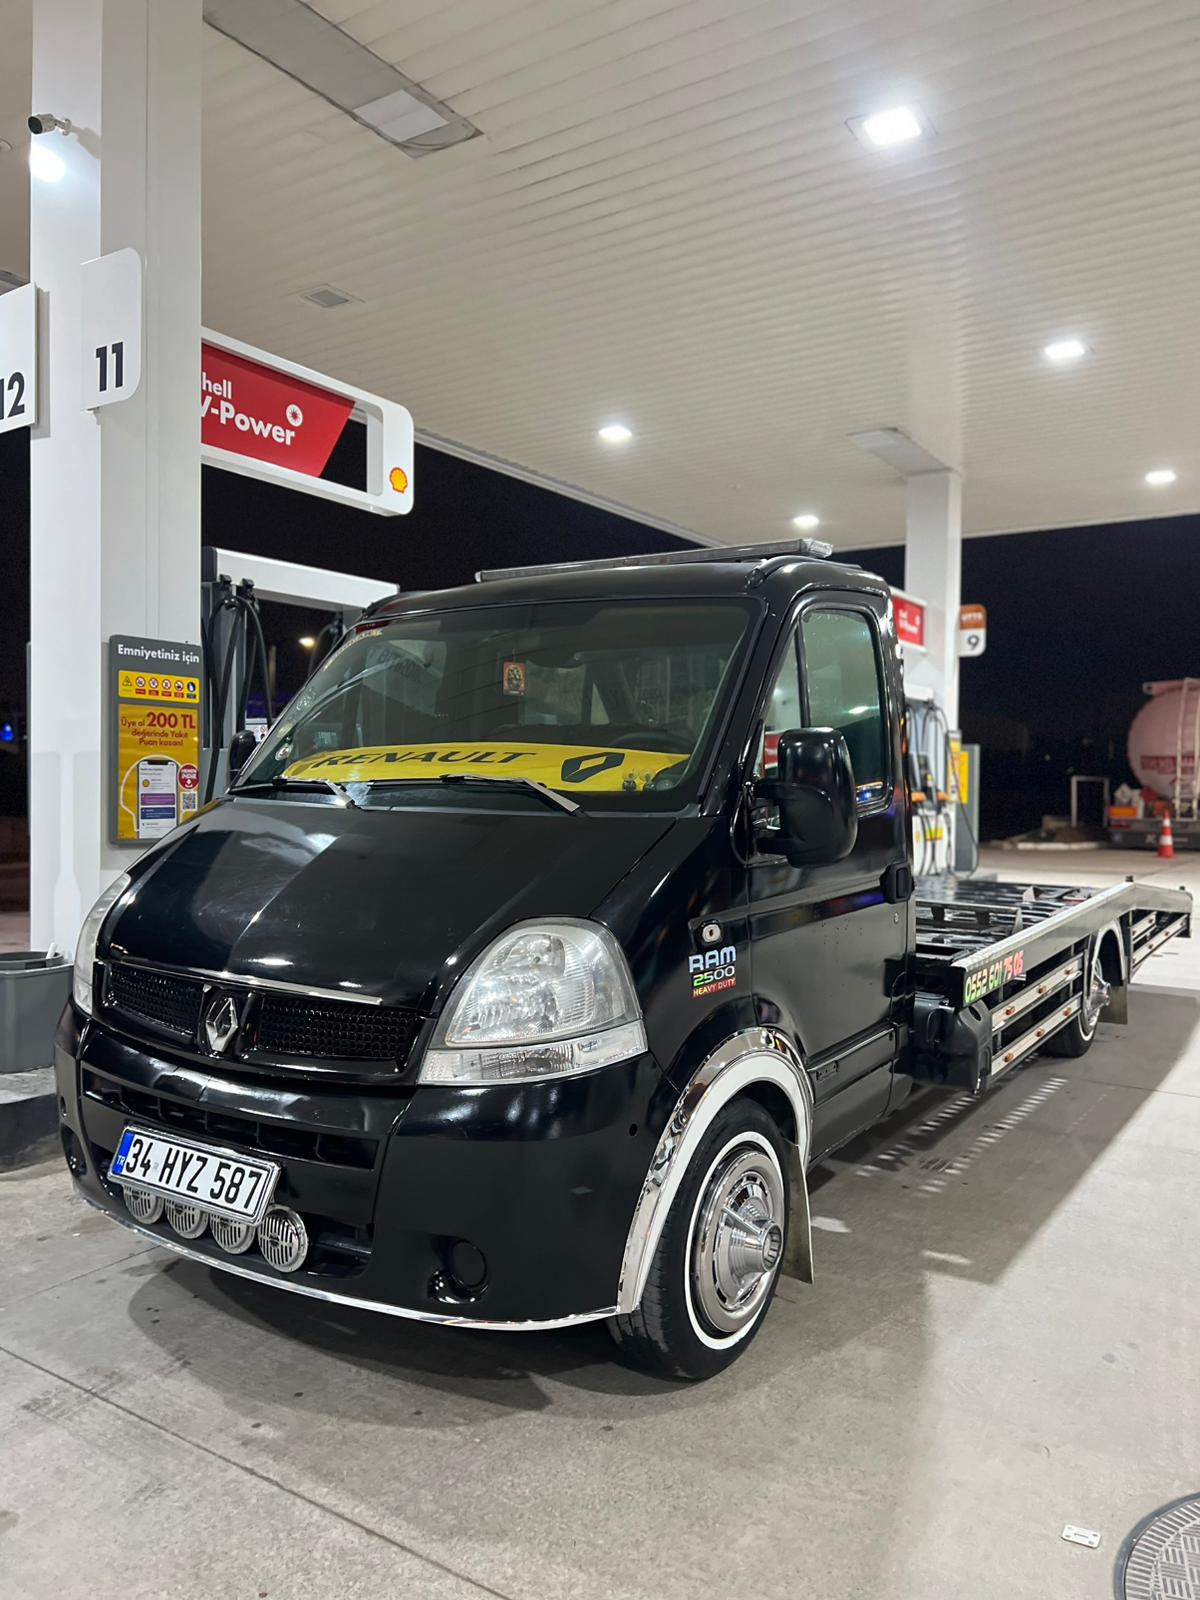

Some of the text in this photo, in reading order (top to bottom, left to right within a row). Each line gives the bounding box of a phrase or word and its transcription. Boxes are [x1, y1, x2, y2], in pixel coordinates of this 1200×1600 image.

[95, 341, 124, 392] 11
[967, 634, 980, 651] 9
[117, 643, 200, 664] Emniyetiniz için
[121, 715, 136, 728] Üye
[146, 711, 178, 729] 200
[181, 713, 196, 729] TL
[312, 751, 536, 769] RENAULT
[688, 945, 737, 973] RAM
[693, 965, 735, 987] 2500
[693, 977, 737, 998] HEAVY DUTY
[116, 1155, 126, 1167] TR
[125, 1139, 263, 1210] 34 HYZ 587
